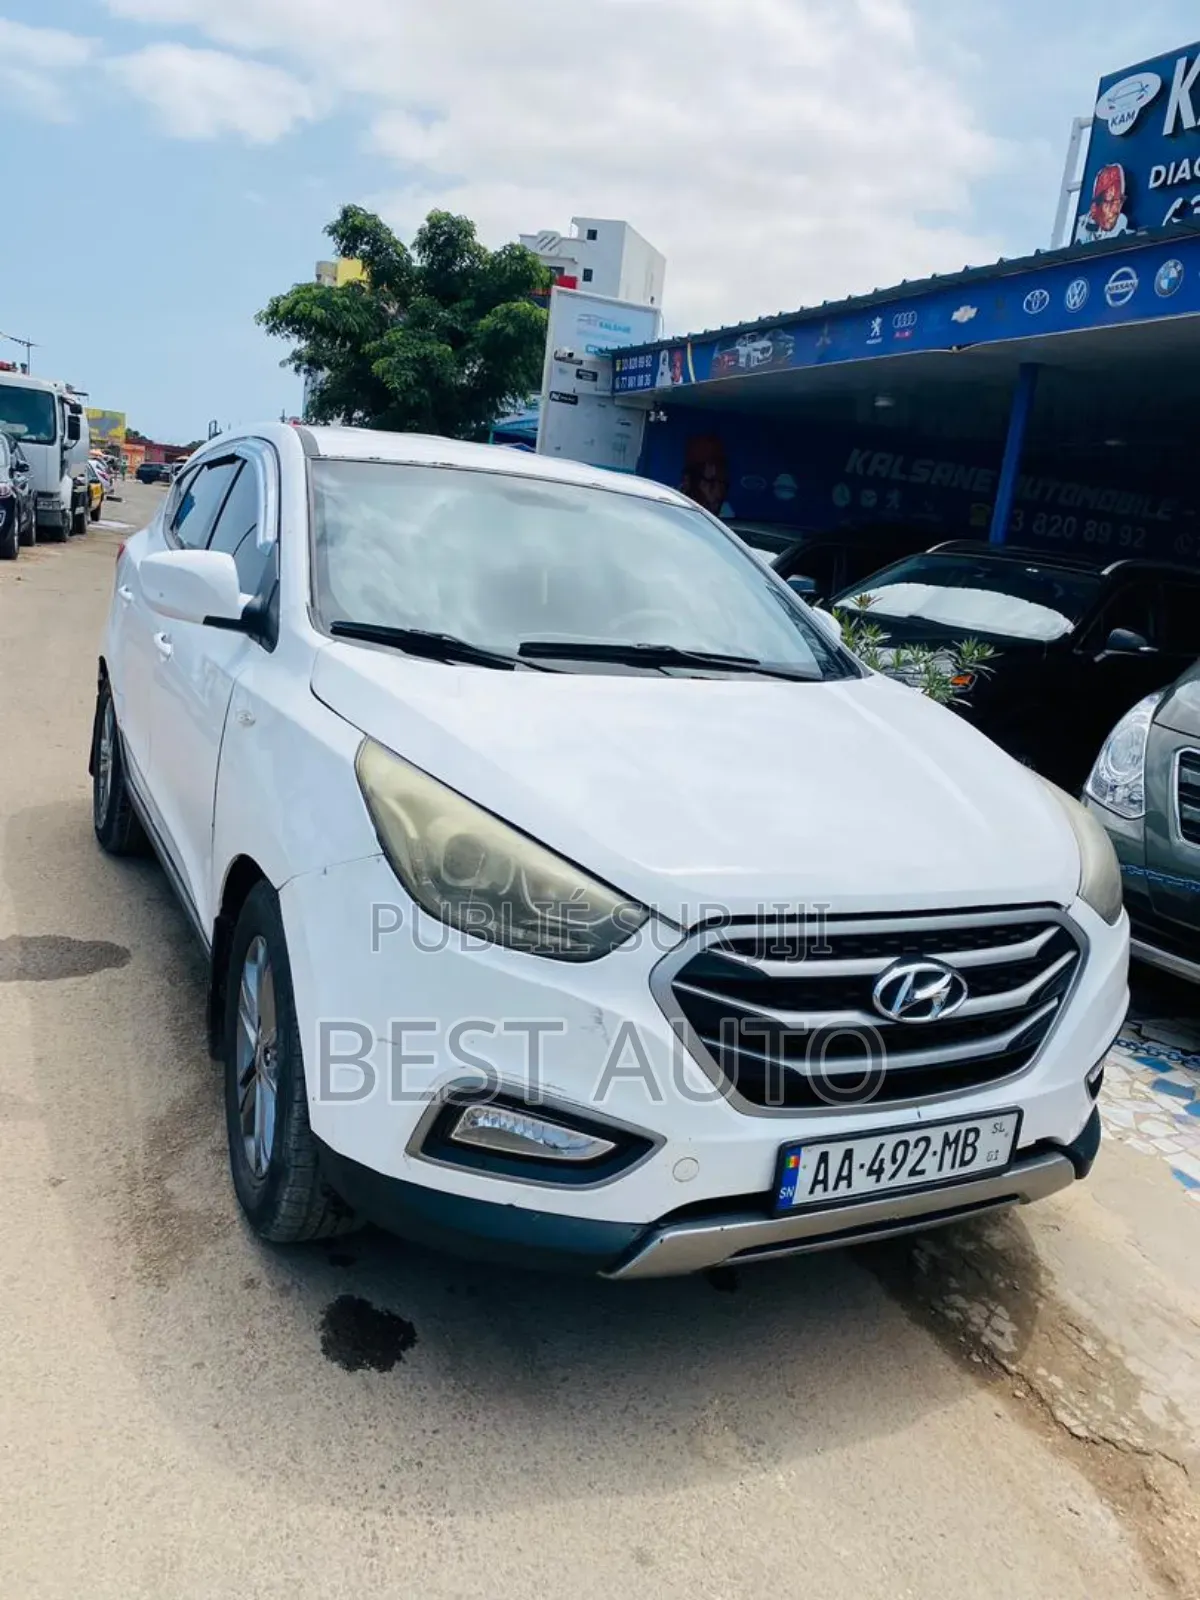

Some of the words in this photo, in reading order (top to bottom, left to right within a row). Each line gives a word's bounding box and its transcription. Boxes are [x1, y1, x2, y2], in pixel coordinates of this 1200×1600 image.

[1163, 53, 1200, 135] K
[1110, 111, 1136, 127] KAM
[1107, 280, 1136, 293] NISSAN
[844, 447, 998, 493] KALSANE
[1032, 511, 1078, 540] 820
[1082, 518, 1113, 544] 89
[1118, 523, 1147, 549] 92
[779, 1186, 795, 1200] SN
